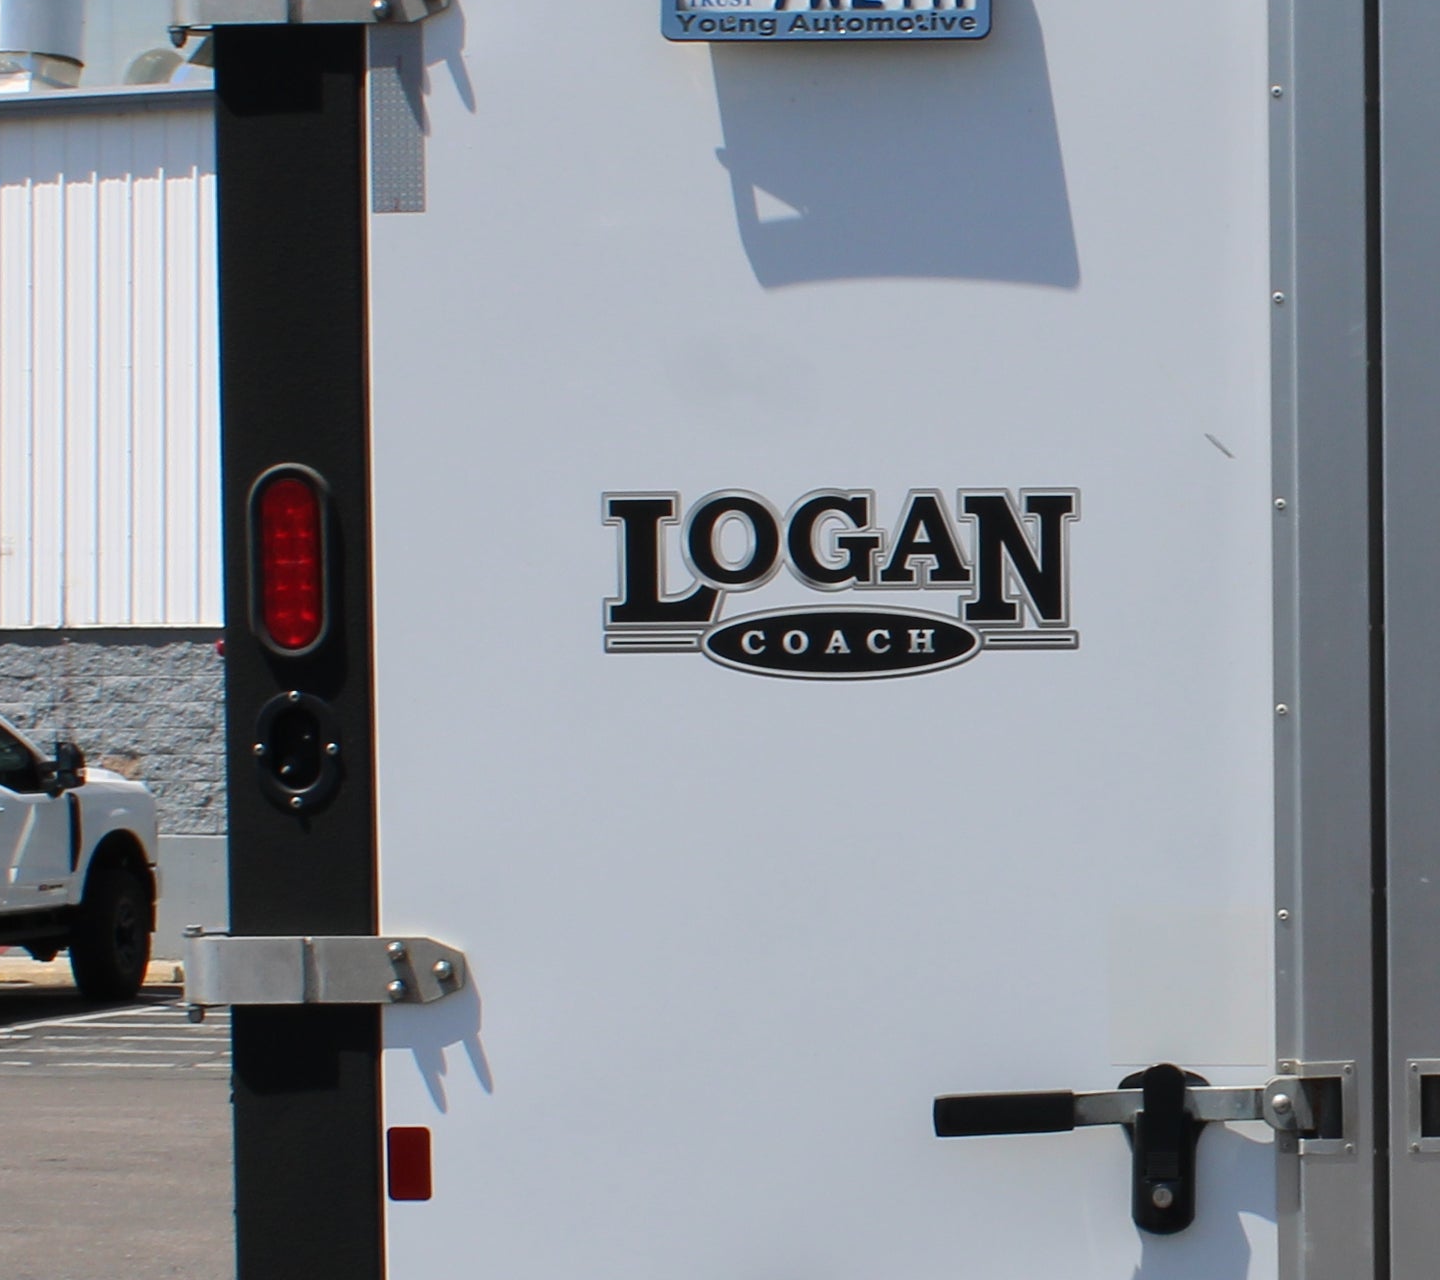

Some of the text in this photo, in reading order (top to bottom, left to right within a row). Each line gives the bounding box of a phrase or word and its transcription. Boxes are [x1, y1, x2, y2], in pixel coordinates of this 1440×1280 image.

[675, 13, 977, 36] Young Automotive
[602, 487, 1081, 631] LOGAN
[741, 628, 936, 655] COACH
